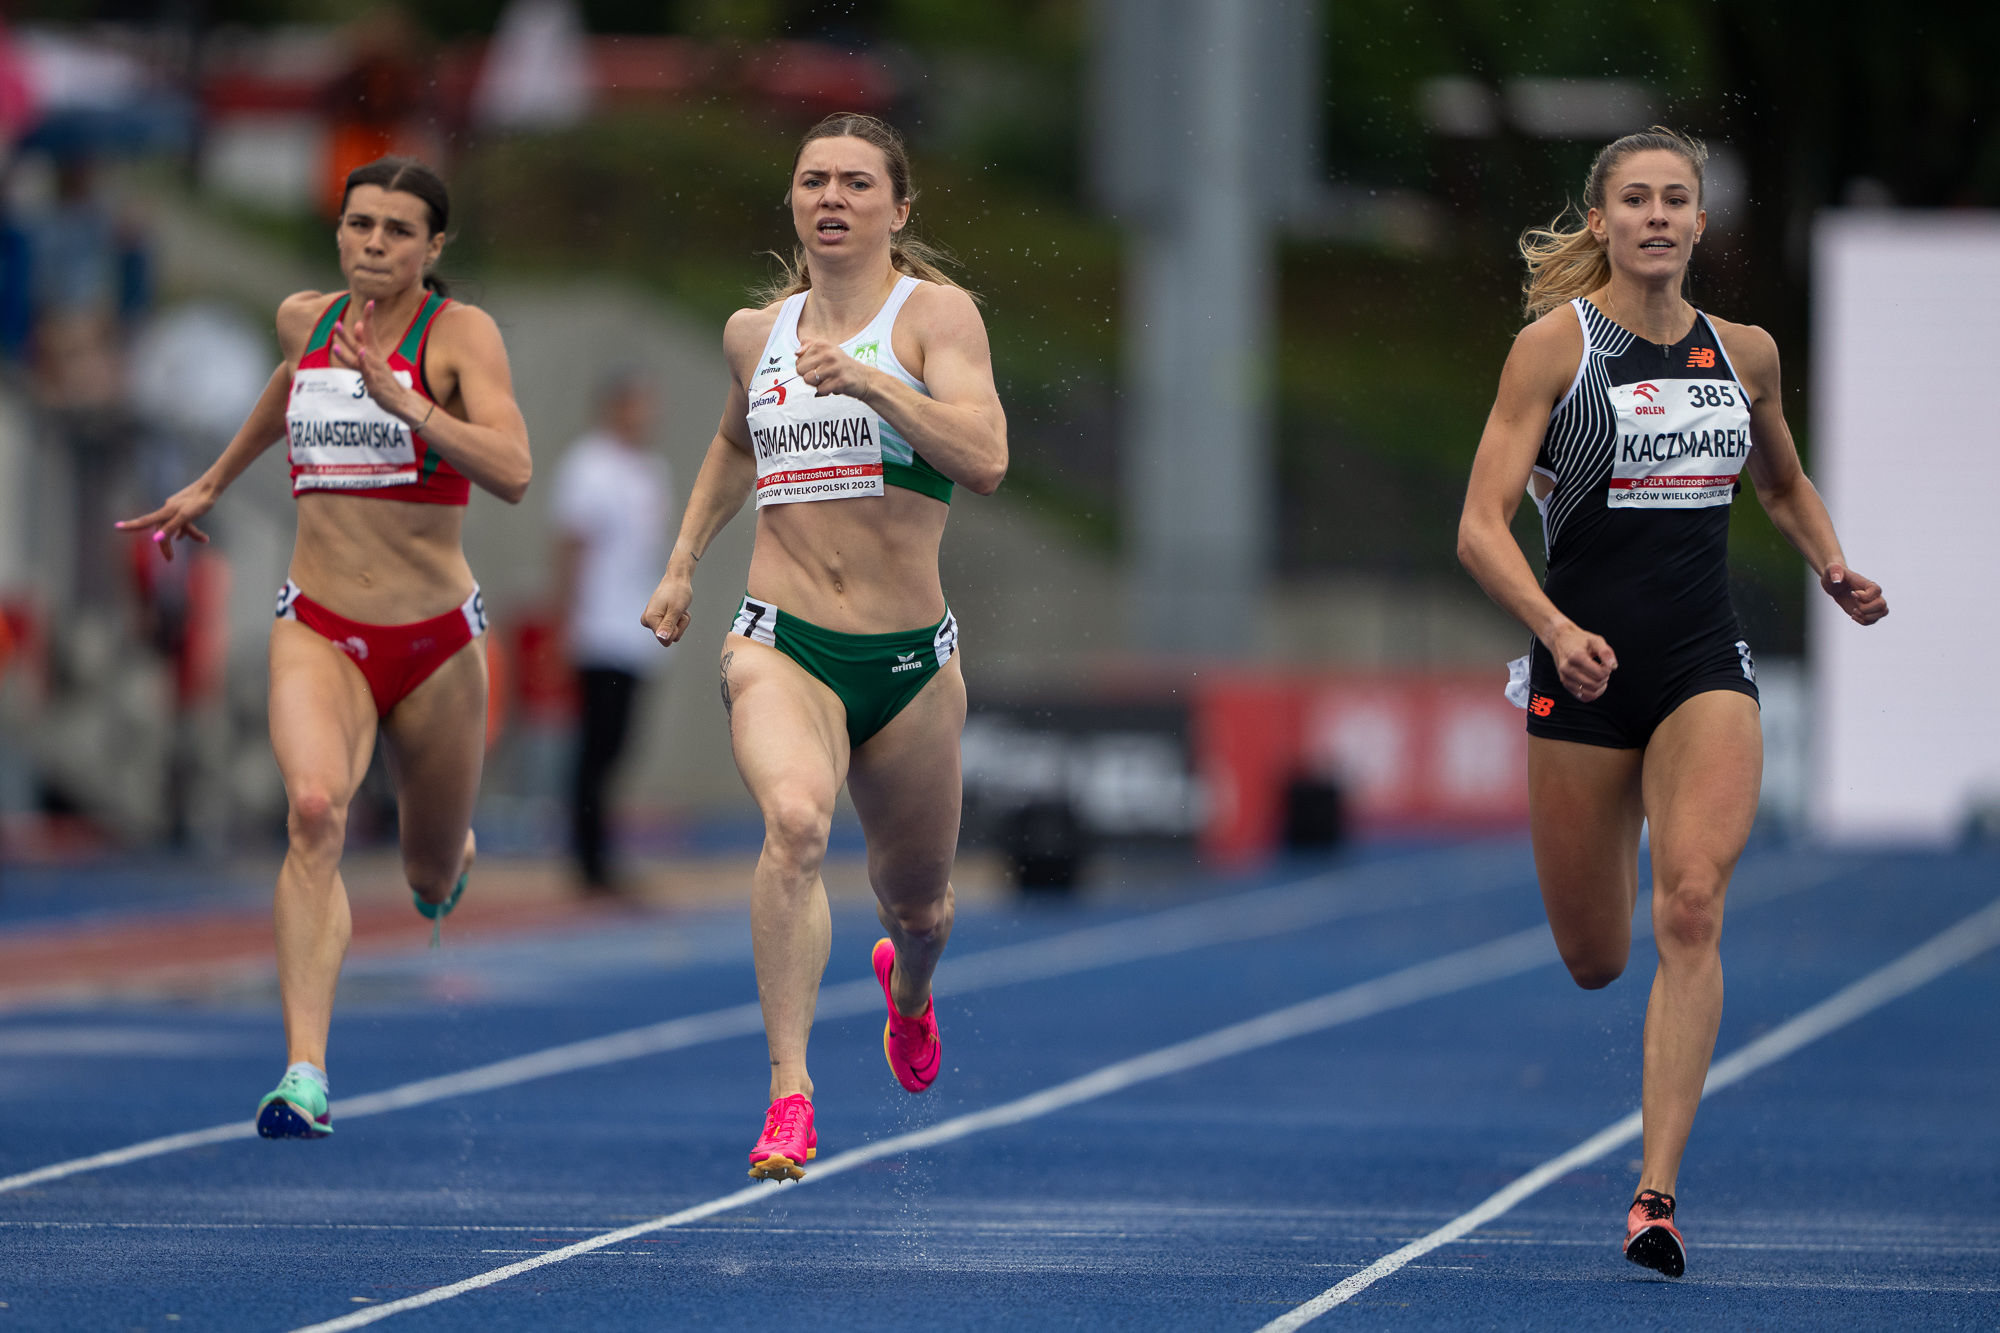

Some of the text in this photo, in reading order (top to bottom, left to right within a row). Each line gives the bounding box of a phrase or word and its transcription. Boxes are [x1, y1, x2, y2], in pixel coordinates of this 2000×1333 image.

[761, 367, 781, 376] erima
[1688, 384, 1735, 408] 385
[1635, 406, 1665, 415] ORLEN
[291, 420, 406, 449] GRANASZEWSKA
[753, 416, 873, 460] TSIMANOUSKAYA
[771, 476, 785, 484] PZLA
[787, 470, 834, 482] Mistrzostwa
[835, 467, 862, 477] Polski
[1643, 478, 1664, 486] PZLA
[1666, 478, 1713, 486] Mistrzostwa
[784, 482, 850, 496] WIELKOPOLSKI
[851, 480, 876, 490] 2023
[1615, 490, 1659, 501] GORZÓW
[1662, 490, 1717, 500] WIELKOPOLSKI
[743, 601, 766, 638] 7
[892, 660, 922, 673] erima
